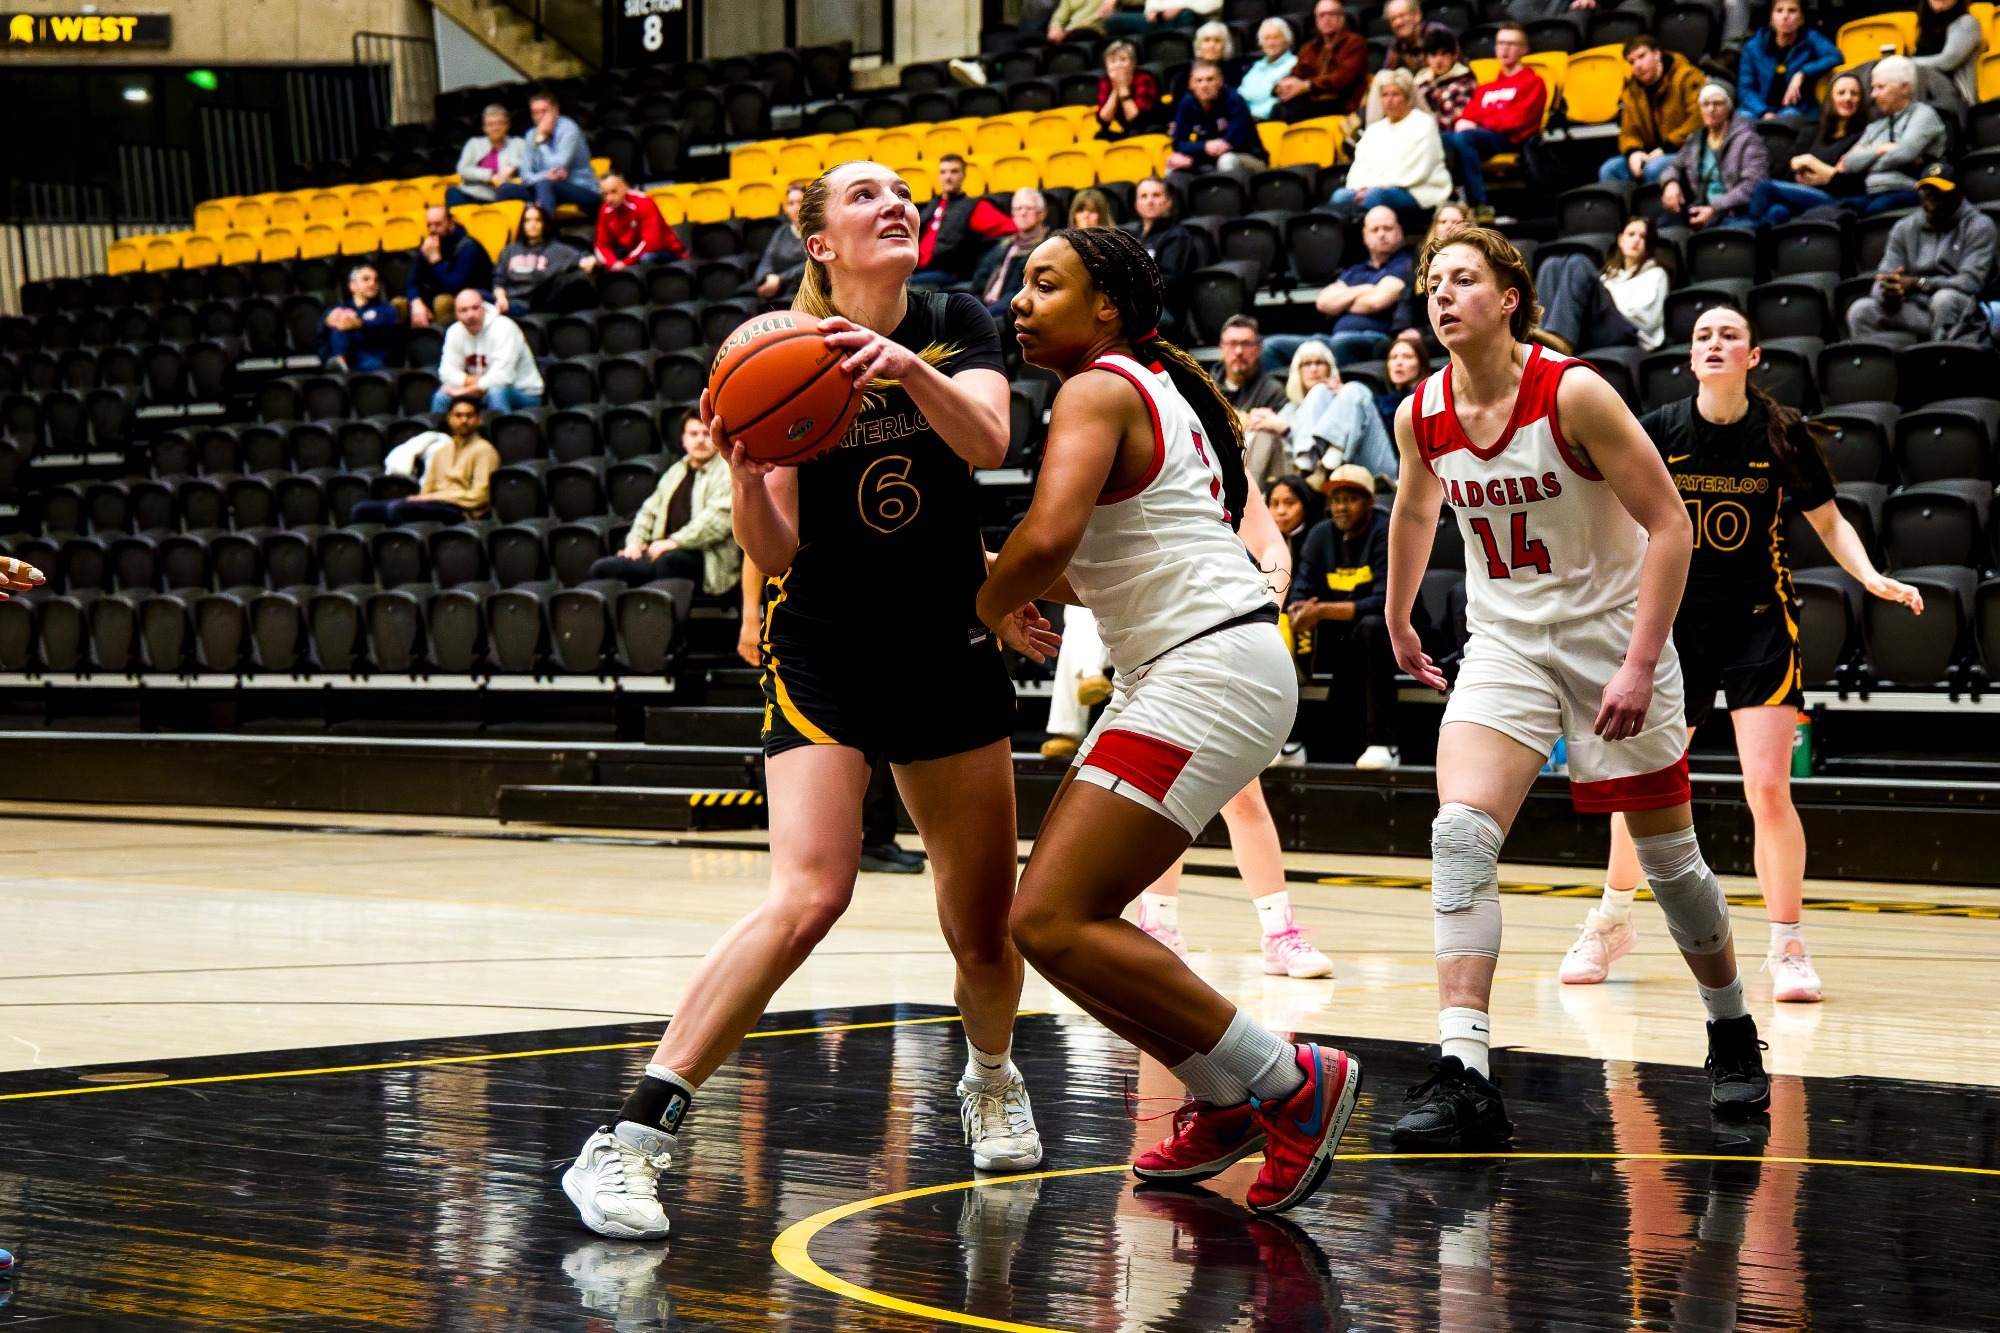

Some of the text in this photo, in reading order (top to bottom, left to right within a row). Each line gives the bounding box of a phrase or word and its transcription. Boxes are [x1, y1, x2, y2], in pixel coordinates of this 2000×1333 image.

[50, 16, 138, 42] WEST
[643, 14, 663, 52] 8
[839, 408, 931, 448] TERLO
[857, 454, 921, 534] 6
[1468, 511, 1552, 579] 14
[1683, 499, 1751, 551] 10
